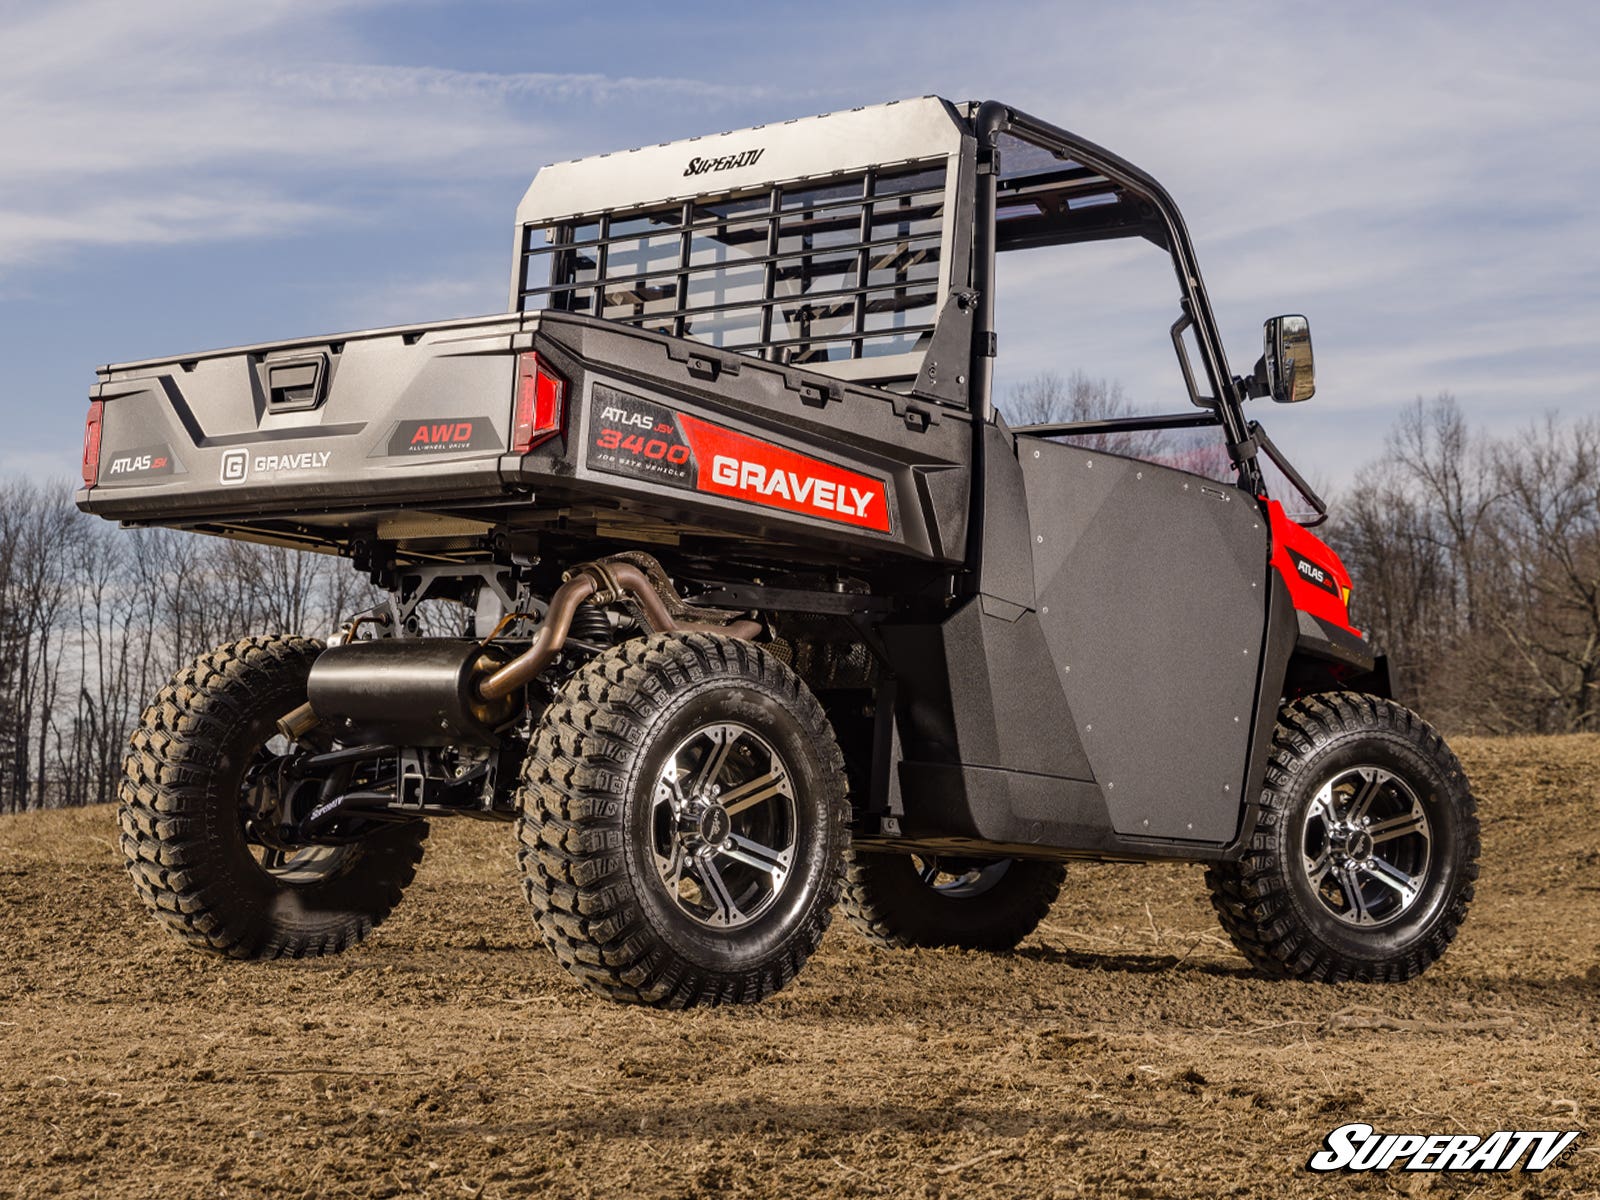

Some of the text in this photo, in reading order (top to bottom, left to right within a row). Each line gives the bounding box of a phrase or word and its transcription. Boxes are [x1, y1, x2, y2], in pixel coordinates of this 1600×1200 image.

[600, 406, 674, 435] ATLAS JSV
[411, 422, 472, 445] AWD
[596, 428, 690, 465] 3400
[110, 454, 152, 474] ATLAS
[254, 451, 331, 472] GRAVELY
[645, 463, 686, 478] VEHICLE
[711, 454, 874, 517] GRAVELY
[1297, 560, 1324, 583] ATLAS
